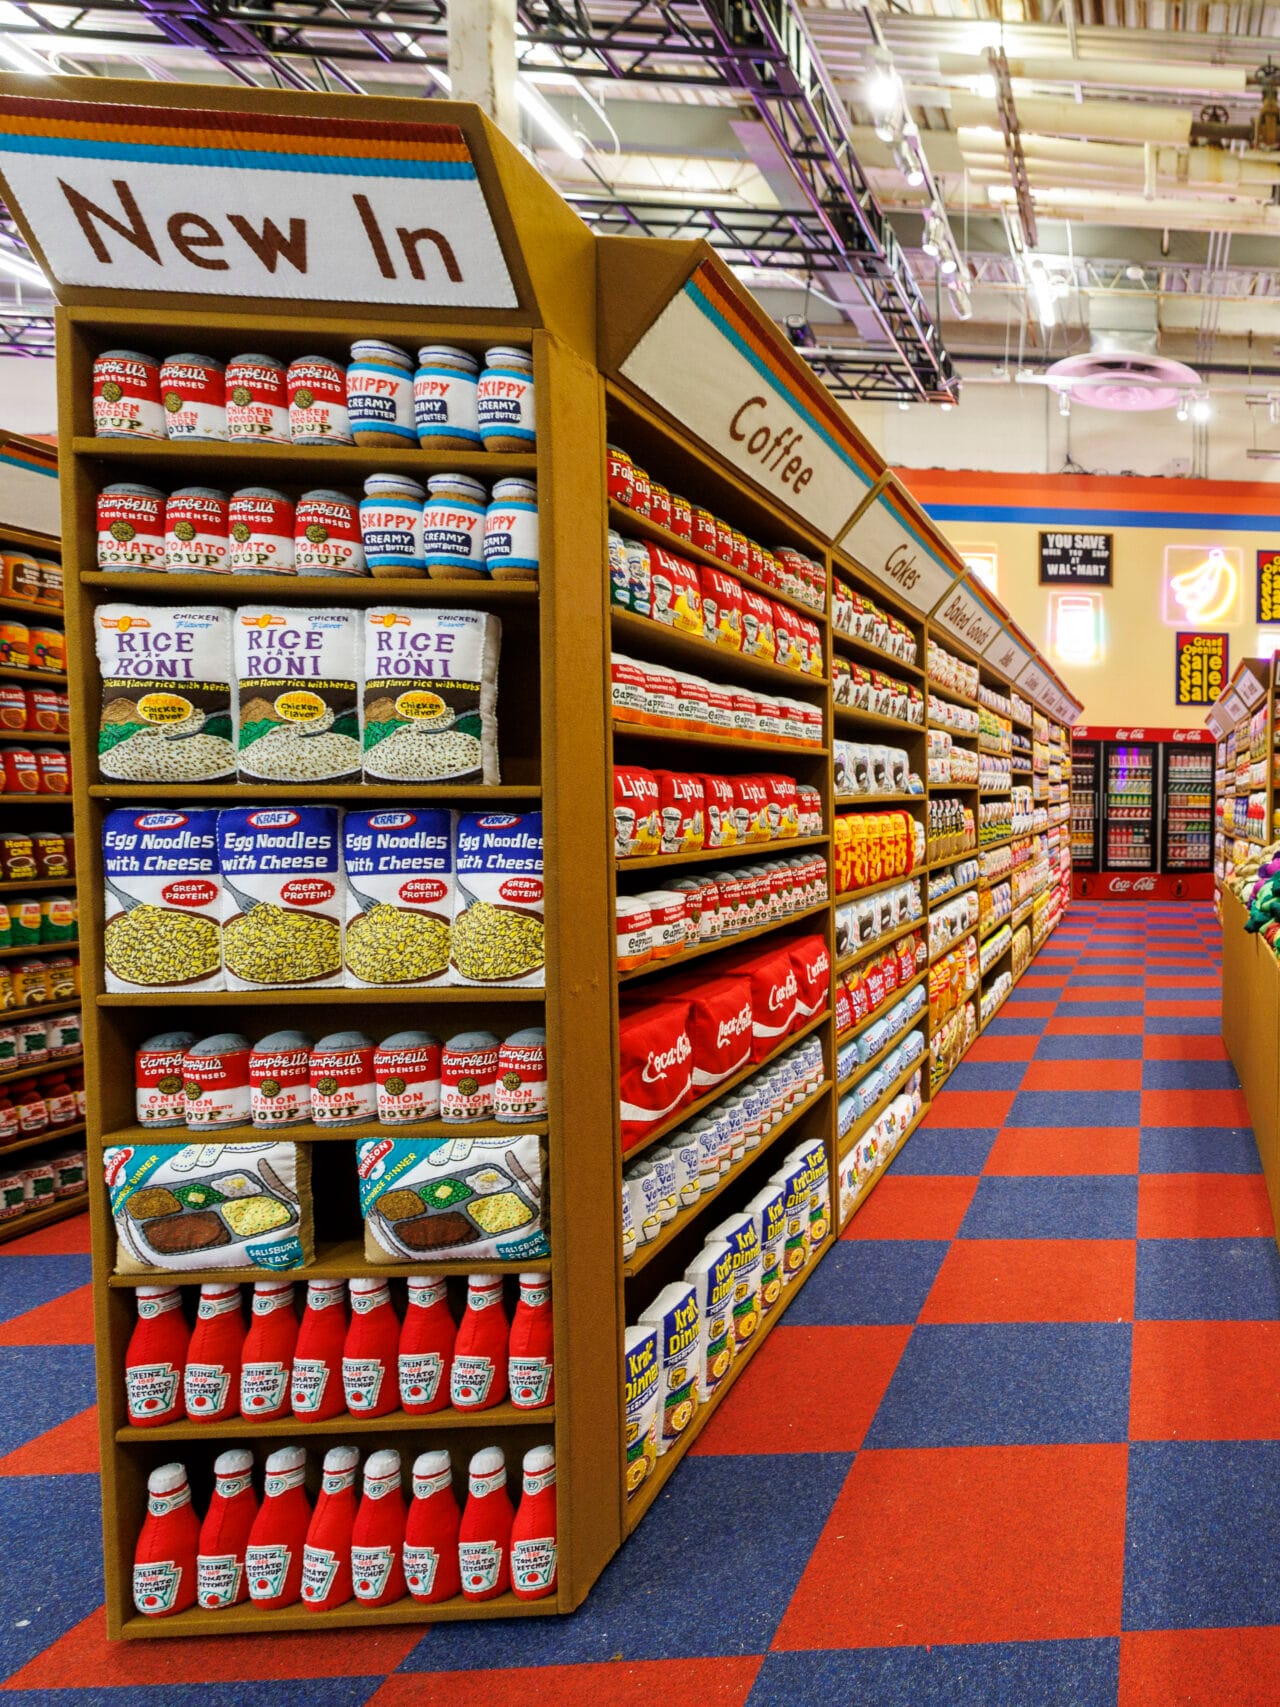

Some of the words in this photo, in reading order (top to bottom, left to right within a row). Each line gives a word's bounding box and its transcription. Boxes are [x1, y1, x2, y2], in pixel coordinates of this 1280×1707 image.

[57, 176, 307, 274] New
[352, 193, 464, 283] In
[347, 376, 399, 397] SKIPPY
[477, 380, 526, 399] SKIPPY
[348, 397, 393, 411] CREAMY
[729, 396, 814, 496] Coffee
[100, 511, 156, 522] CONDENSED
[361, 512, 417, 531] SKIPPY
[424, 511, 478, 531] SKIPPY
[365, 533, 412, 545] CREAMY
[424, 532, 466, 544] CREAMY
[1046, 533, 1073, 549] YOU
[1074, 534, 1106, 550] SAVE
[98, 540, 165, 557] TOMATO
[296, 541, 353, 557] TOMATO
[99, 551, 156, 564] SOUP
[296, 552, 347, 565] SOUP
[1070, 557, 1080, 565] AT
[655, 548, 698, 584] Lipton
[884, 543, 921, 591] Cakes
[172, 613, 220, 622] CHICKEN
[308, 615, 350, 623] CHICKEN
[437, 614, 478, 624] CHICKEN
[943, 595, 971, 631] Baked
[965, 616, 993, 647] Goods
[115, 631, 194, 653] RICE
[247, 629, 323, 651] RICE
[377, 631, 456, 653] RICE
[1193, 636, 1222, 647] Grand
[113, 657, 195, 678] RONI
[247, 655, 321, 677] RONI
[376, 656, 452, 678] RONI
[155, 681, 176, 690] rice
[178, 682, 200, 691] with
[203, 683, 231, 693] herbs
[400, 701, 441, 710] Chicken
[617, 775, 659, 802] Lipton
[142, 814, 180, 826] KRAFT
[255, 813, 291, 825] KRAFT
[373, 813, 406, 826] KRAFT
[105, 831, 137, 850] Egg
[141, 830, 215, 850] Noodles
[224, 832, 254, 852] Egg
[256, 831, 331, 850] Noodles
[345, 832, 373, 851] Egg
[376, 831, 448, 849] Noodles
[458, 832, 480, 851] Egg
[106, 856, 140, 872] with
[144, 855, 213, 872] Cheese
[222, 855, 257, 871] with
[260, 855, 328, 870] Cheese
[346, 857, 373, 873] with
[378, 855, 445, 871] Cheese
[456, 856, 482, 870] with
[486, 853, 544, 871] Cheese
[172, 884, 205, 893] GREAT
[288, 883, 324, 892] GREAT
[407, 883, 440, 891] GREAT
[507, 881, 537, 889] GREAT
[1109, 877, 1158, 892] Coca-Cola
[165, 889, 215, 901] PROTEIN!
[283, 888, 331, 900] PROTEIN!
[402, 888, 443, 899] PROTEIN!
[502, 887, 542, 899] PROTEIN!
[375, 1064, 427, 1075] CONDENSED
[379, 1092, 423, 1105] ONION
[381, 1105, 429, 1119] SOUP
[358, 1141, 389, 1178] SWANSON
[384, 1152, 417, 1181] DINNER
[131, 1154, 160, 1185] DINNER
[250, 1239, 299, 1257] SALISBURY
[499, 1234, 546, 1255] SALISBURY
[256, 1251, 290, 1265] STEAK
[509, 1246, 542, 1259] STEAK
[314, 1296, 326, 1304] 57
[133, 1371, 161, 1380] HEINZ
[130, 1380, 171, 1392] TOMATO
[131, 1386, 171, 1398] KETCHUP
[520, 1544, 547, 1554] HEINZ
[515, 1554, 551, 1565] TOMATO
